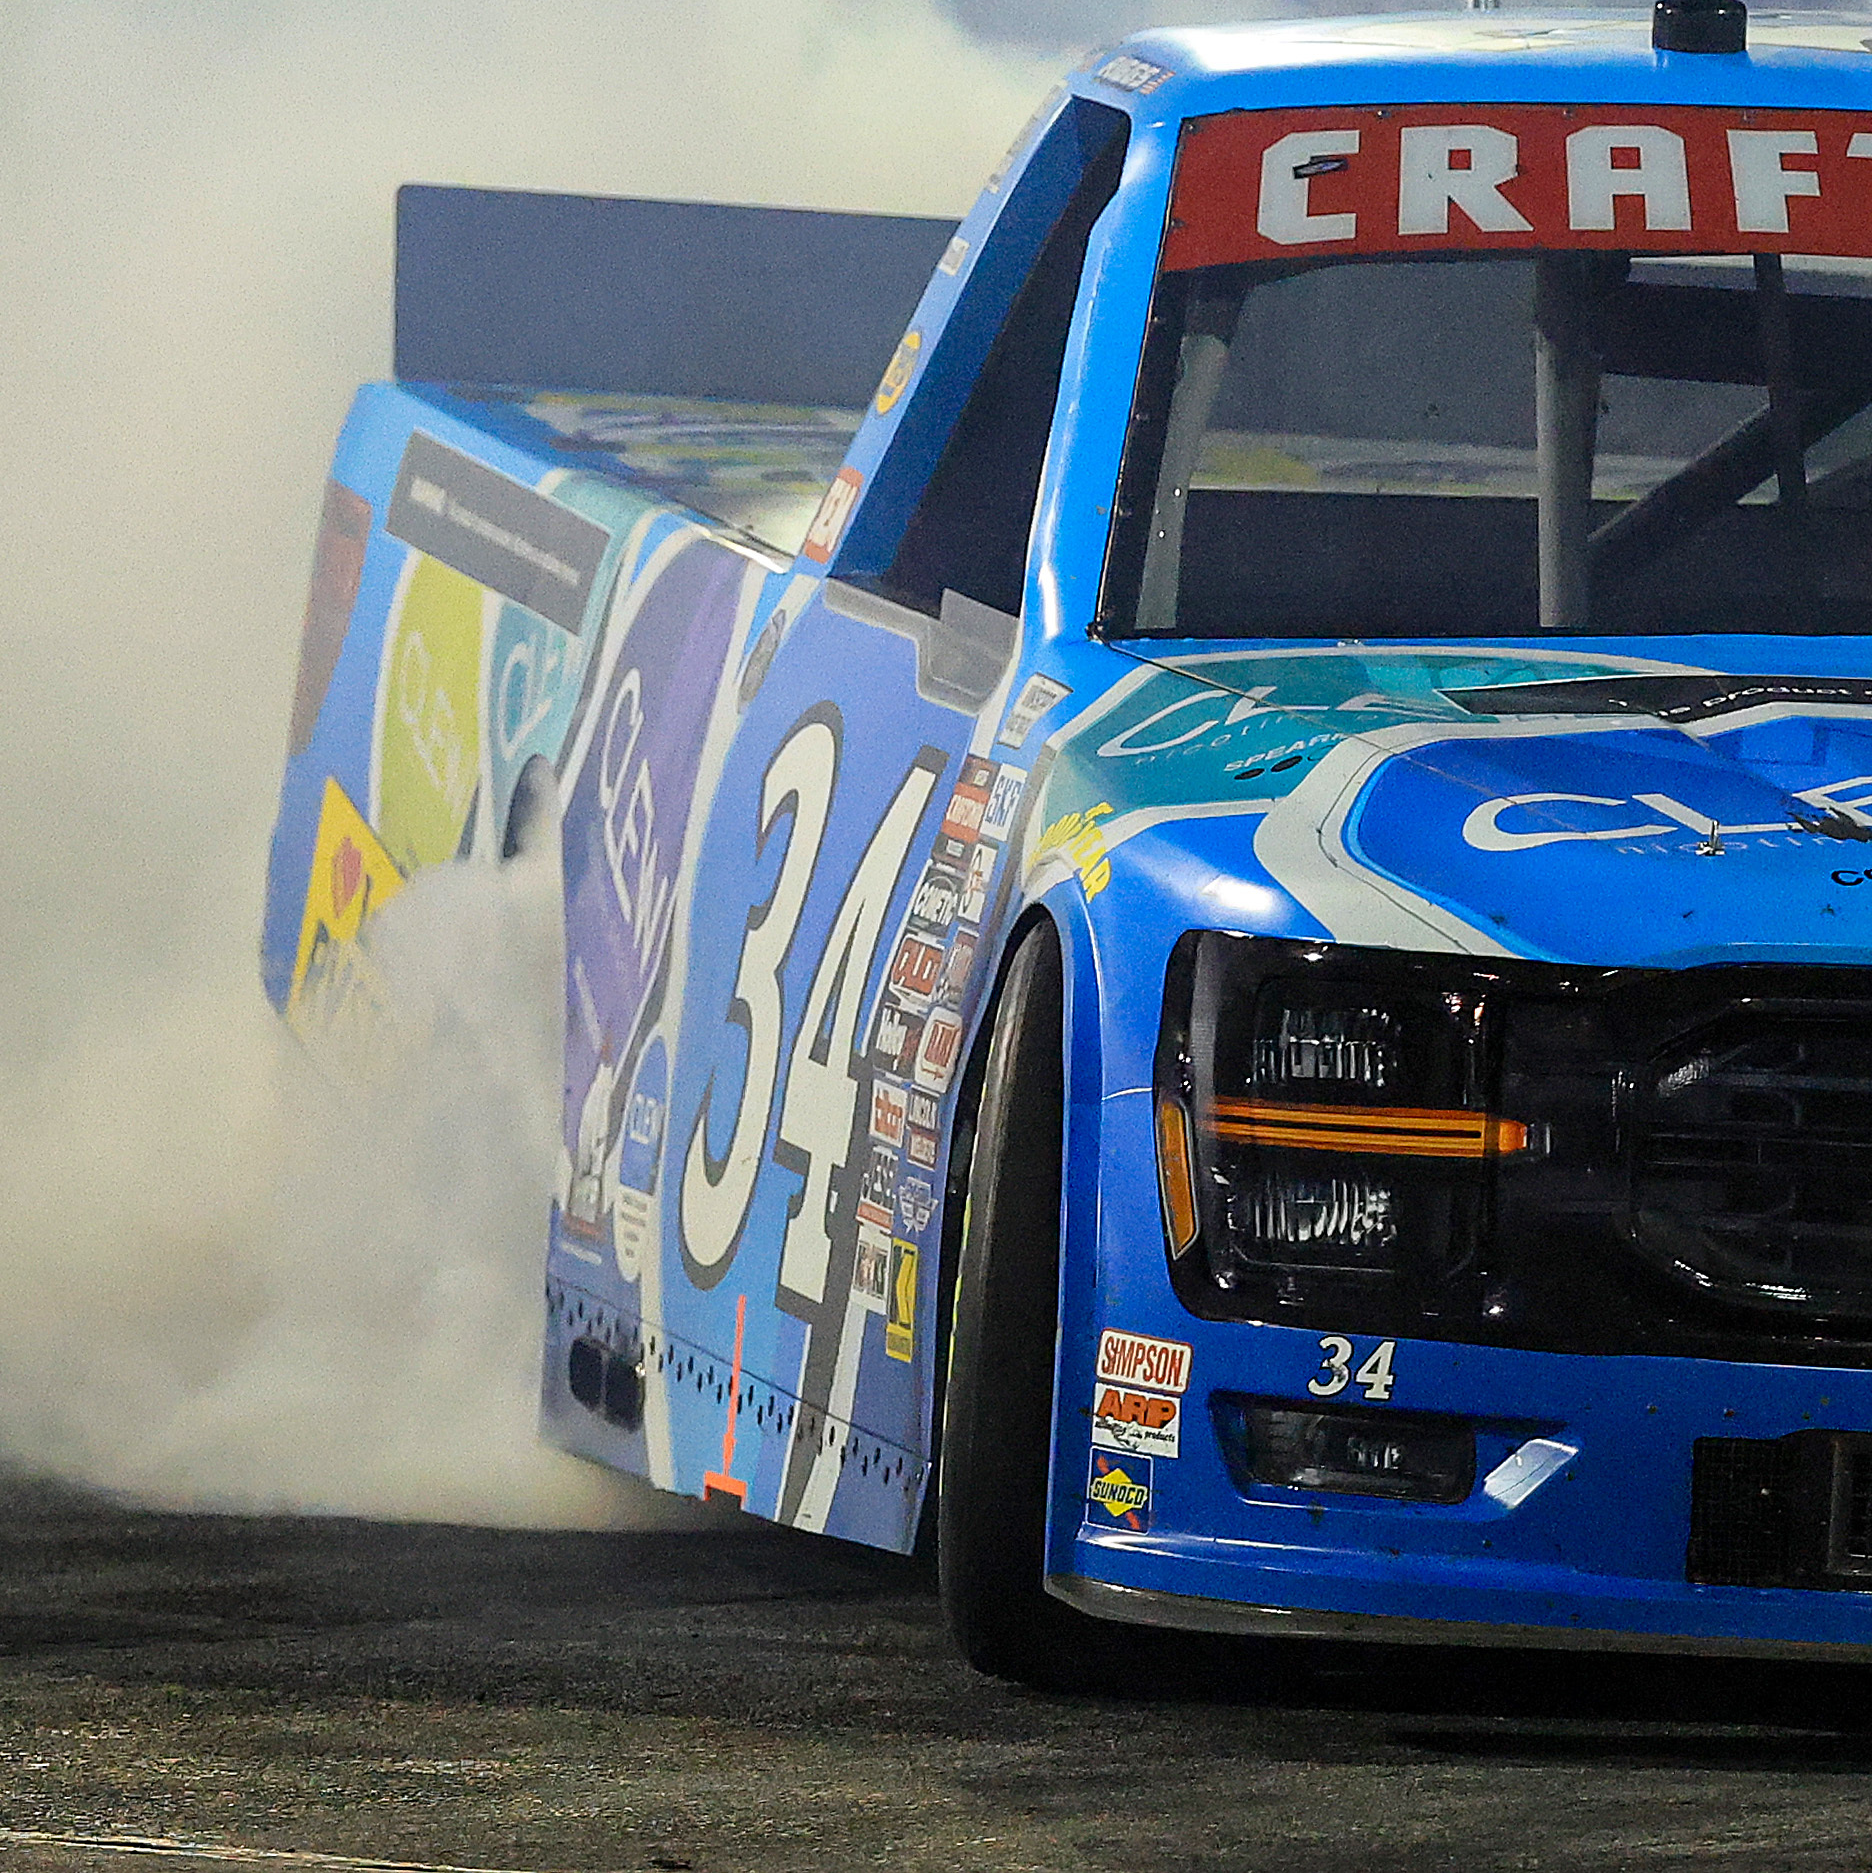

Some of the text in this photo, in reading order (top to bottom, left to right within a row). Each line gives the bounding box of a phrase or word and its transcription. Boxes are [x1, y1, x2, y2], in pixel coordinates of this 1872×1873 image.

[1703, 686, 1852, 708] product
[987, 774, 1022, 828] SKF
[681, 706, 943, 1316] 34
[1101, 1335, 1184, 1387] SIMPSON
[1307, 1334, 1398, 1402] 34
[1096, 1388, 1177, 1428] ARP
[1092, 1479, 1145, 1507] SUNOCO
